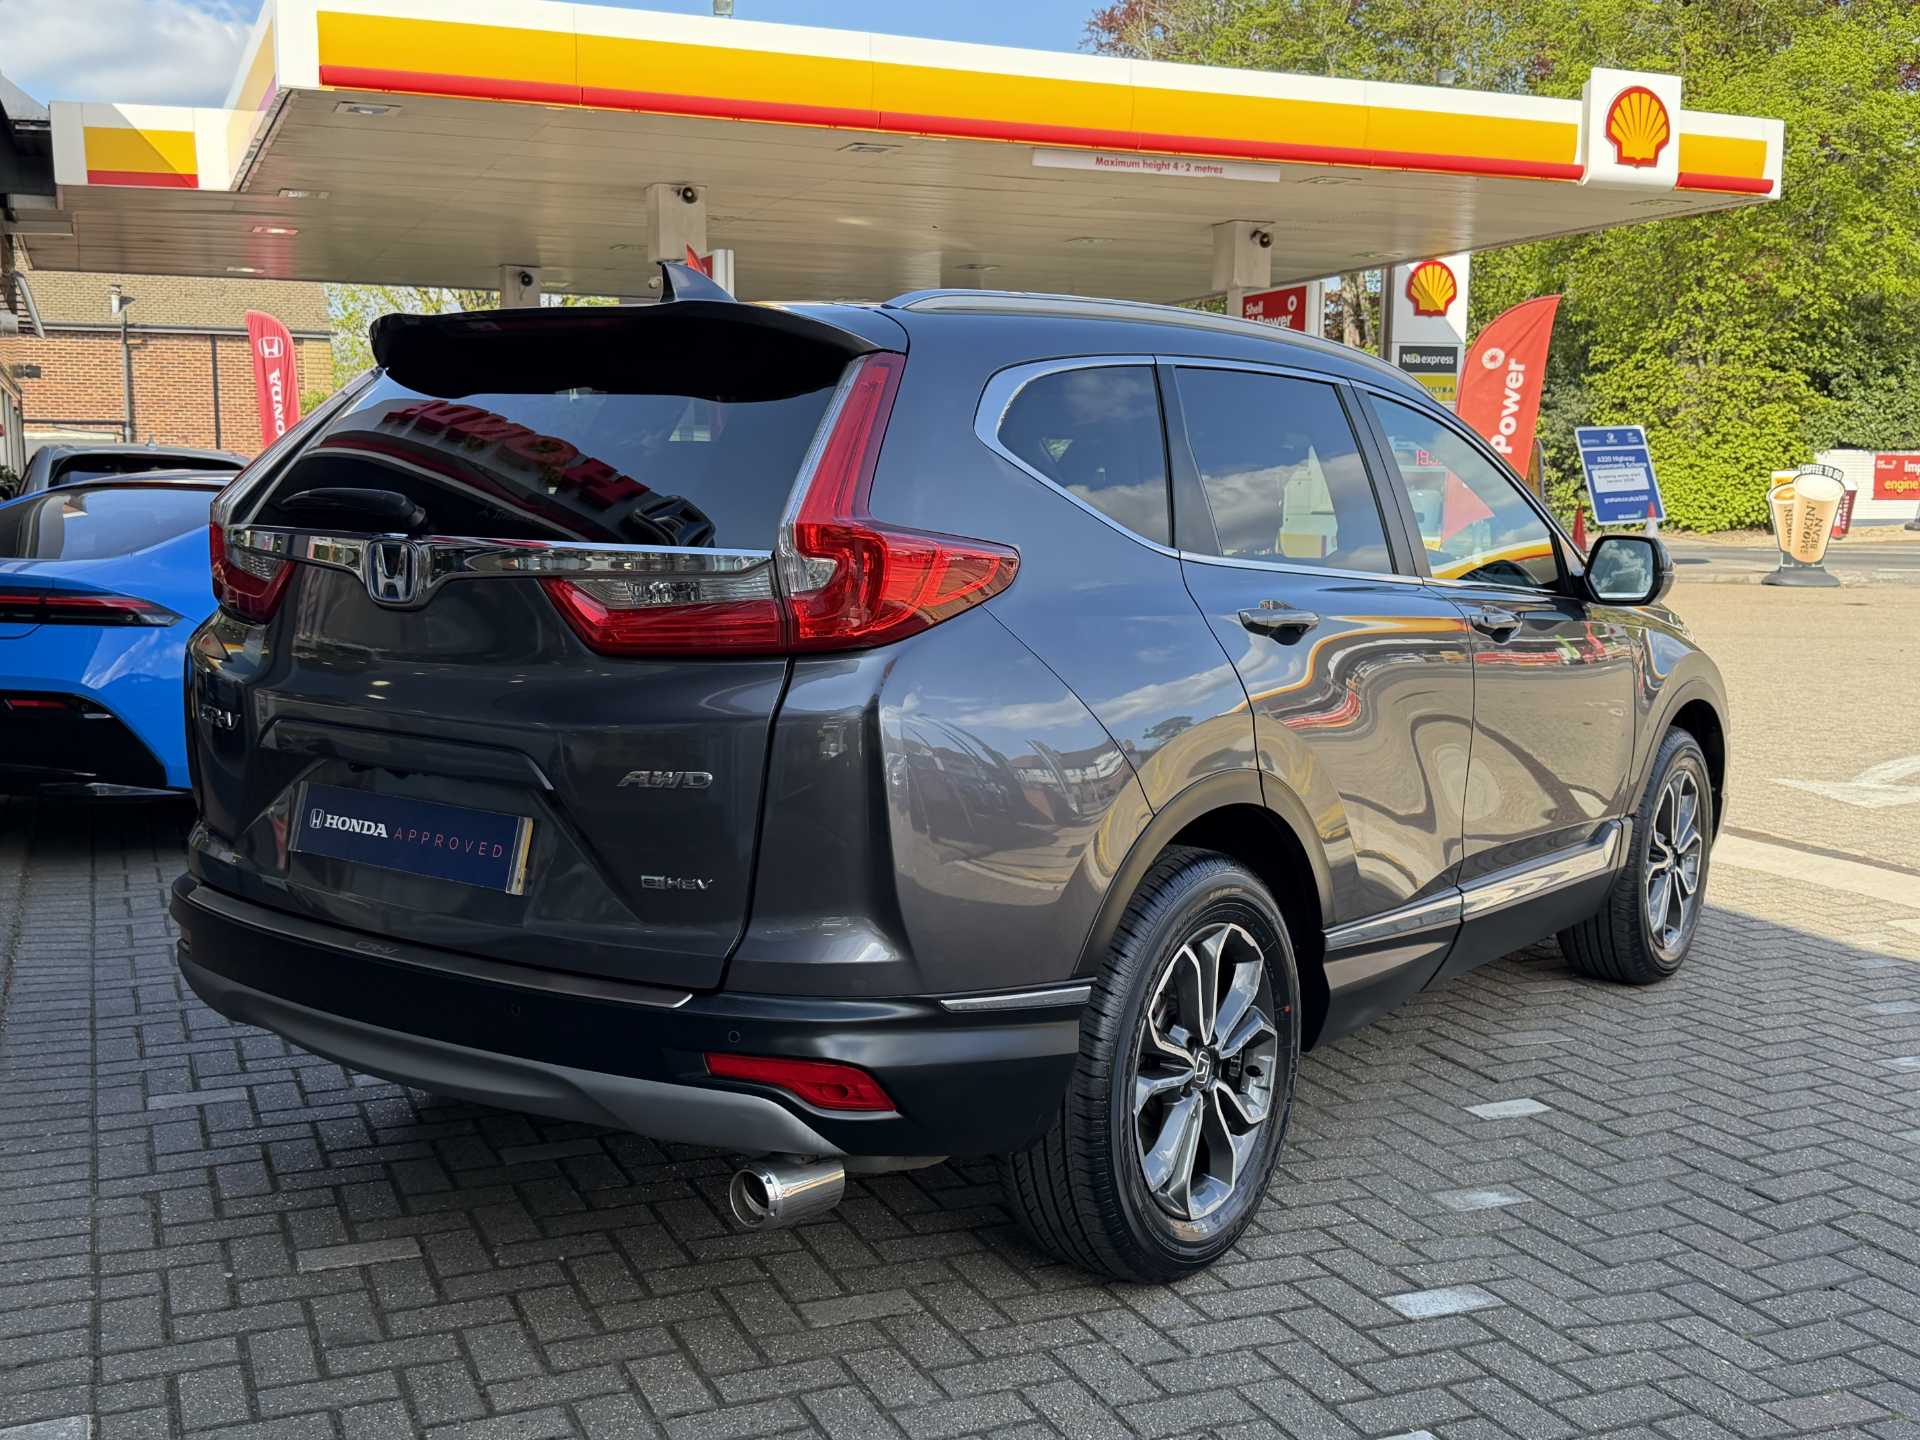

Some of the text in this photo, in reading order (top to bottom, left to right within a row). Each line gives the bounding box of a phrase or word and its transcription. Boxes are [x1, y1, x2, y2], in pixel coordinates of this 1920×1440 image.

[1095, 157, 1140, 168] Maximum
[1142, 158, 1170, 172] height
[1194, 164, 1223, 174] metres
[1246, 300, 1264, 314] Shell
[1421, 354, 1454, 367] express
[269, 368, 285, 438] ONDA
[1801, 464, 1824, 474] COFFEE
[1824, 466, 1834, 477] TO
[1810, 517, 1824, 549] BEAN
[616, 770, 713, 789] AWD
[324, 813, 503, 858] HONDA APPROVED
